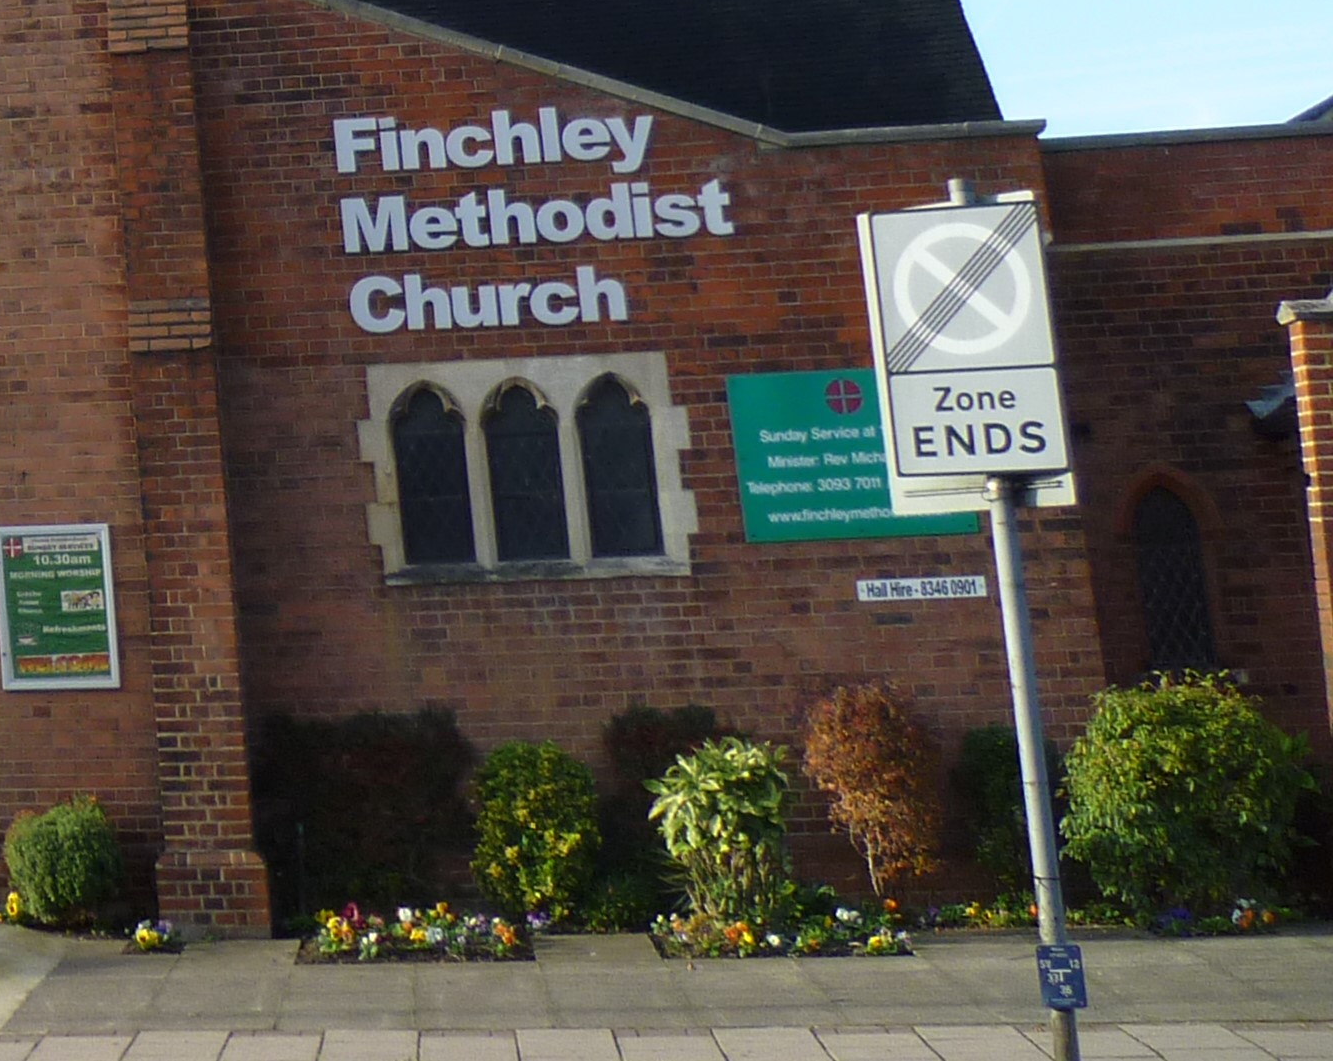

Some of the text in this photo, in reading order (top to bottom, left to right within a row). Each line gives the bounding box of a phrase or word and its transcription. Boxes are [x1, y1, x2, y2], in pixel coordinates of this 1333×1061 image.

[333, 107, 653, 173] Finchley
[339, 178, 734, 254] Methodist
[349, 265, 628, 334] Church
[933, 386, 1016, 412] Zone
[759, 430, 807, 444] Sunday
[810, 427, 859, 440] Service
[863, 425, 876, 438] at
[912, 420, 1047, 458] ENDS
[767, 455, 819, 468] Minister:
[823, 453, 848, 466] Rev
[746, 476, 881, 496] Telephone: 3093 7011
[33, 554, 91, 565] 10.30am
[56, 568, 102, 578] WORSHIP
[866, 582, 887, 598] Hall
[890, 581, 913, 597] Hire
[920, 580, 949, 596] 8346
[950, 579, 978, 595] 0901
[42, 624, 106, 634] Refreshments
